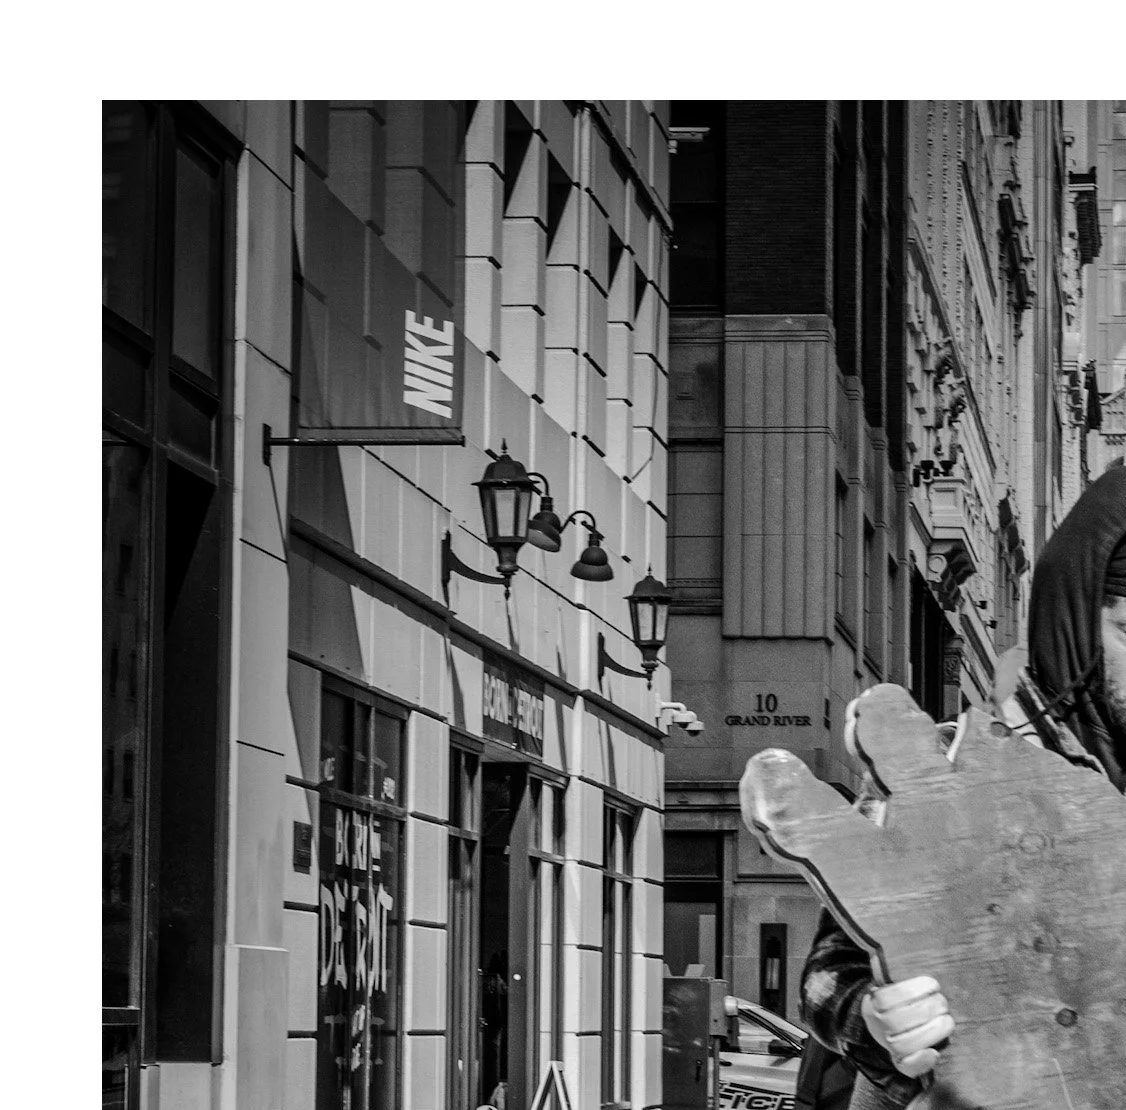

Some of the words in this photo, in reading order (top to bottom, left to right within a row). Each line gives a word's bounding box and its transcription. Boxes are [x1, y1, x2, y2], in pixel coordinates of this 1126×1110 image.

[403, 309, 455, 419] NIKE
[754, 693, 778, 713] 10
[724, 715, 771, 726] GRAND
[773, 715, 812, 727] RIVER
